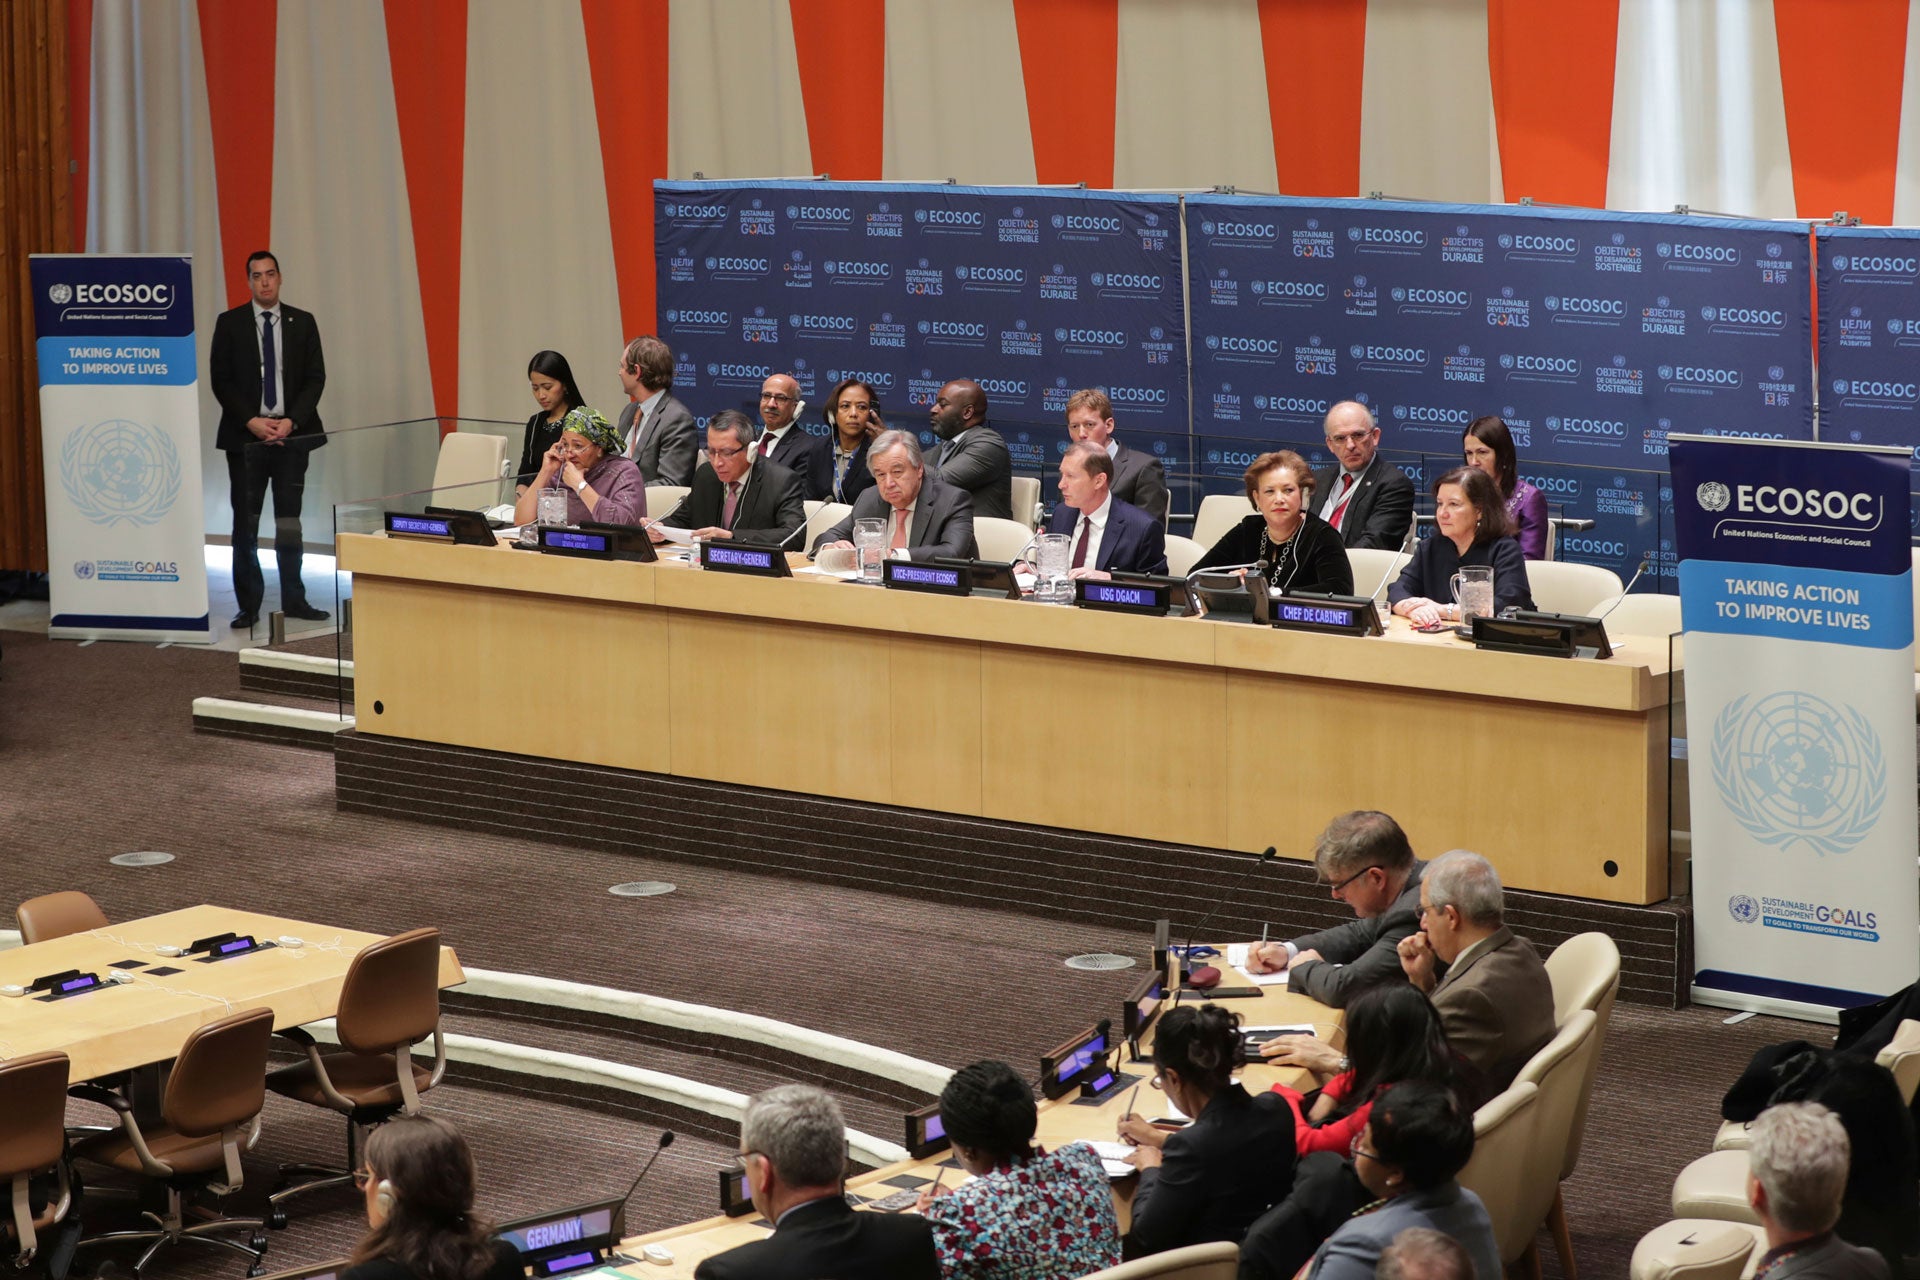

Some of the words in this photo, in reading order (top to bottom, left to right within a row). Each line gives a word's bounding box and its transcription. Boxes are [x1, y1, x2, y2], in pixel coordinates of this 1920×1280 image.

[678, 206, 726, 217] ECOSOC
[801, 207, 850, 220] ECOSOC
[930, 210, 981, 224] ECOSOC
[741, 224, 775, 235] GOALS
[1067, 216, 1120, 230] ECOSOC
[1218, 223, 1274, 237] ECOSOC
[867, 228, 902, 236] DURABLE
[1365, 229, 1423, 244] ECOSOC
[1442, 238, 1483, 247] OBJECTIFS
[1516, 236, 1575, 251] ECOSOC
[1294, 245, 1334, 258] GOALS
[1443, 253, 1483, 263] DURABLE
[1595, 246, 1641, 256] OBJETIVOS
[1675, 245, 1735, 261] ECOSOC
[720, 258, 767, 270] ECOSOC
[839, 262, 888, 275] ECOSOC
[1596, 263, 1641, 272] SOSTENIBLE
[1852, 257, 1916, 272] ECOSOC
[971, 267, 1023, 281] ECOSOC
[1107, 274, 1160, 288] ECOSOC
[906, 283, 943, 295] GOALS
[1210, 280, 1237, 290] ЦЕЛИ
[1268, 282, 1325, 296] ECOSOC
[76, 284, 168, 303] ECOSOC
[1040, 290, 1077, 300] DURABLE
[1409, 289, 1467, 304] ECOSOC
[1487, 299, 1529, 307] SUSTAINABLE
[1563, 298, 1622, 314] ECOSOC
[680, 311, 728, 323] ECOSOC
[1643, 308, 1685, 318] OBJECTIFS
[1720, 308, 1782, 324] ECOSOC
[804, 316, 854, 329] ECOSOC
[1487, 314, 1529, 328] GOALS
[1840, 319, 1871, 330] ЦЕЛИ
[933, 322, 984, 336] ECOSOC
[1643, 324, 1685, 334] DURABLE
[743, 331, 778, 342] GOALS
[870, 337, 905, 347] DURABLE
[1071, 330, 1124, 344] ECOSOC
[1002, 347, 1042, 355] SOSTENIBLE
[1222, 338, 1277, 352] ECOSOC
[1295, 348, 1336, 356] SUSTAINABLE
[69, 348, 112, 358] TAKING
[115, 348, 160, 358] ACTION
[1367, 347, 1425, 362] ECOSOC
[1296, 362, 1336, 374] GOALS
[1444, 356, 1485, 366] OBJECTIFS
[1517, 356, 1576, 372] ECOSOC
[63, 364, 79, 374] TO
[83, 364, 135, 374] IMPROVE
[138, 364, 168, 374] LIVES
[722, 364, 769, 377] ECOSOC
[1596, 368, 1643, 379] OBJETIVOS
[1676, 367, 1738, 384] ECOSOC
[1444, 371, 1485, 382] DURABLE
[1111, 387, 1165, 402] ECOSOC
[1597, 385, 1643, 394] SOSTENIBLE
[1852, 381, 1915, 397] ECOSOC
[1214, 394, 1240, 404] ЦЕЛИ
[1270, 397, 1326, 413] ECOSOC
[1410, 407, 1468, 423] ECOSOC
[1564, 418, 1623, 435] ECOSOC
[1644, 445, 1668, 455] DURA
[1224, 452, 1257, 465] ECOS
[1597, 505, 1643, 515] SOSTENIBLE
[1737, 485, 1873, 521] ECOSOC
[1723, 529, 1745, 537] United
[1747, 531, 1773, 539] Nations
[1775, 532, 1807, 542] Economic
[1823, 536, 1842, 545] Social
[1844, 538, 1871, 547] Council
[1564, 538, 1624, 556] ECOSOC
[711, 550, 769, 567] SECRETARY-GENERAL
[135, 562, 177, 573] GOALS
[894, 569, 935, 582] VICE-PRESIDENT
[936, 573, 956, 584] ECOSOC
[1101, 588, 1114, 601] USG
[1116, 590, 1140, 603] DGACM
[1725, 579, 1789, 598] TAKING
[1793, 585, 1859, 605] ACTION
[1284, 606, 1302, 620] CHEF
[1304, 608, 1313, 621] DE
[1316, 609, 1347, 624] CABINET
[1716, 602, 1740, 618] TO
[1745, 604, 1822, 625] IMPROVE
[1827, 611, 1870, 630] LIVES
[1762, 897, 1814, 912] SUSTAINABLE
[1763, 906, 1814, 920] DEVELOPMENT
[1816, 906, 1876, 929] GOALS
[1772, 920, 1792, 928] GOALS
[1803, 924, 1838, 934] TRANSFORM
[1853, 931, 1874, 939] WORLD
[527, 1219, 582, 1250] GERMANY
